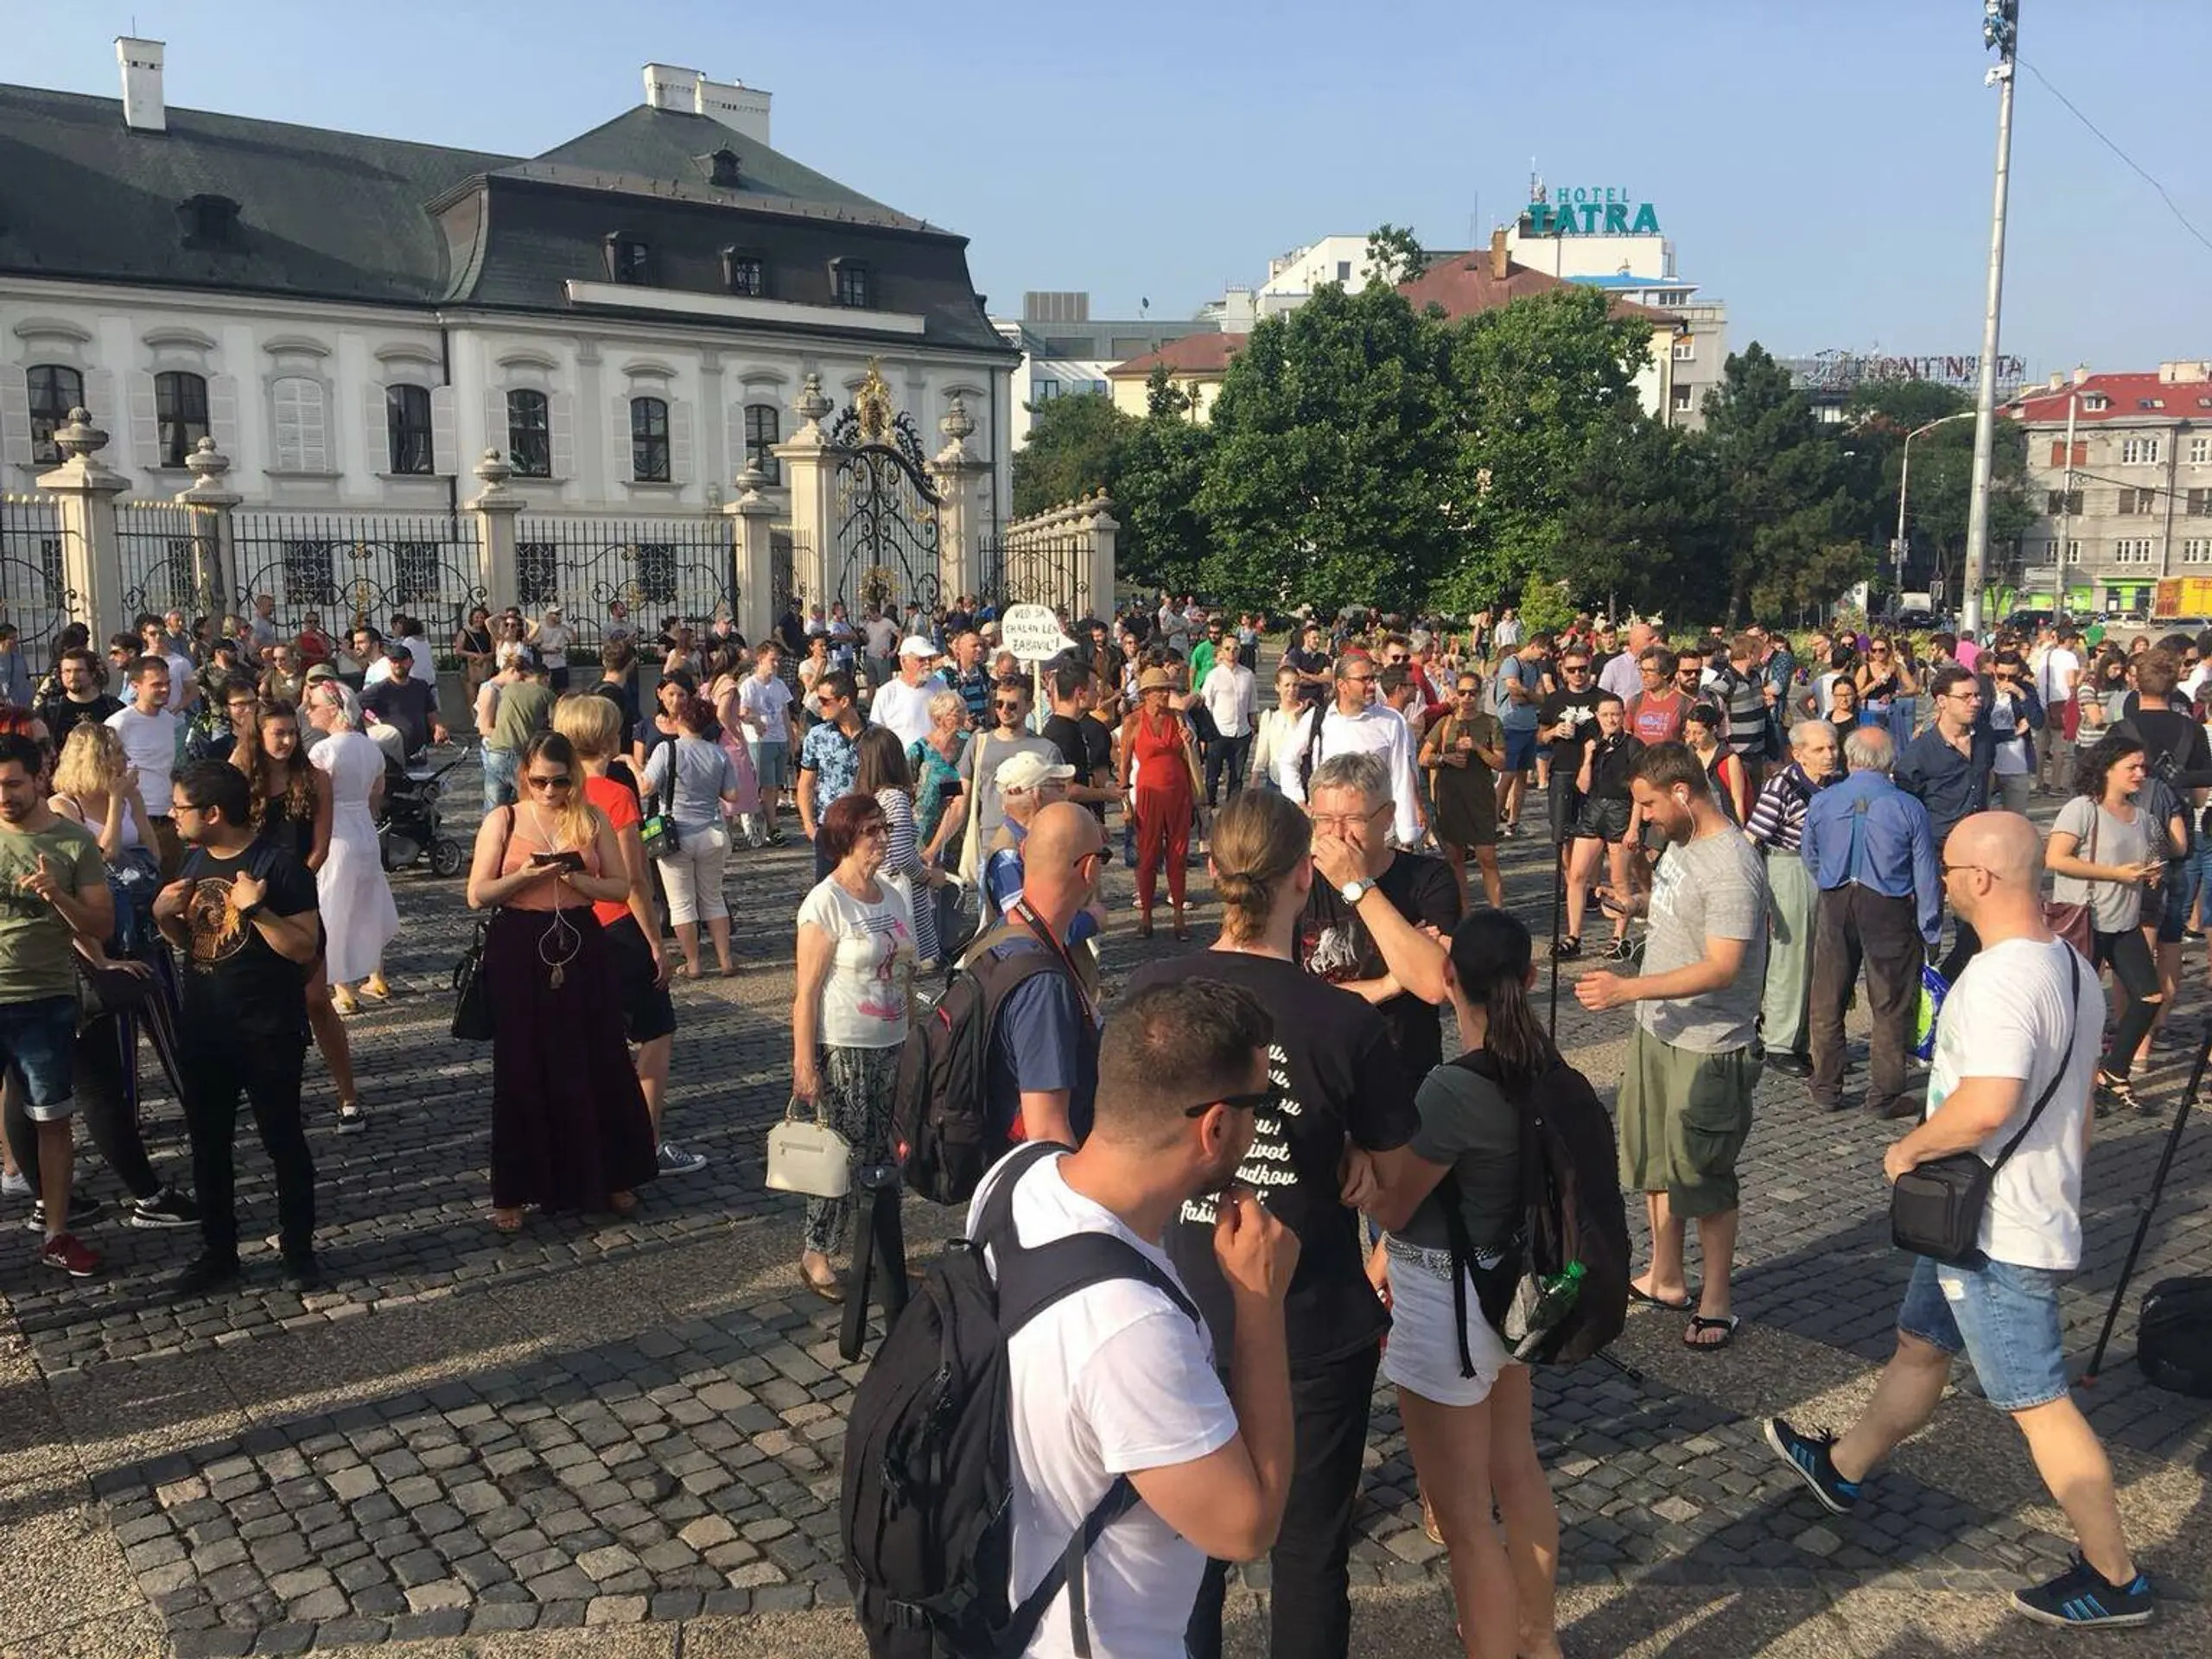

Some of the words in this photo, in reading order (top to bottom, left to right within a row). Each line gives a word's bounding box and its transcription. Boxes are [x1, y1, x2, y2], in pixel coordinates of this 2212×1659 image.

[1557, 187, 1630, 203] HOTEL
[1528, 203, 1661, 234] TATRA
[1243, 1138, 1291, 1161] ivot
[1235, 1164, 1298, 1185] udkov
